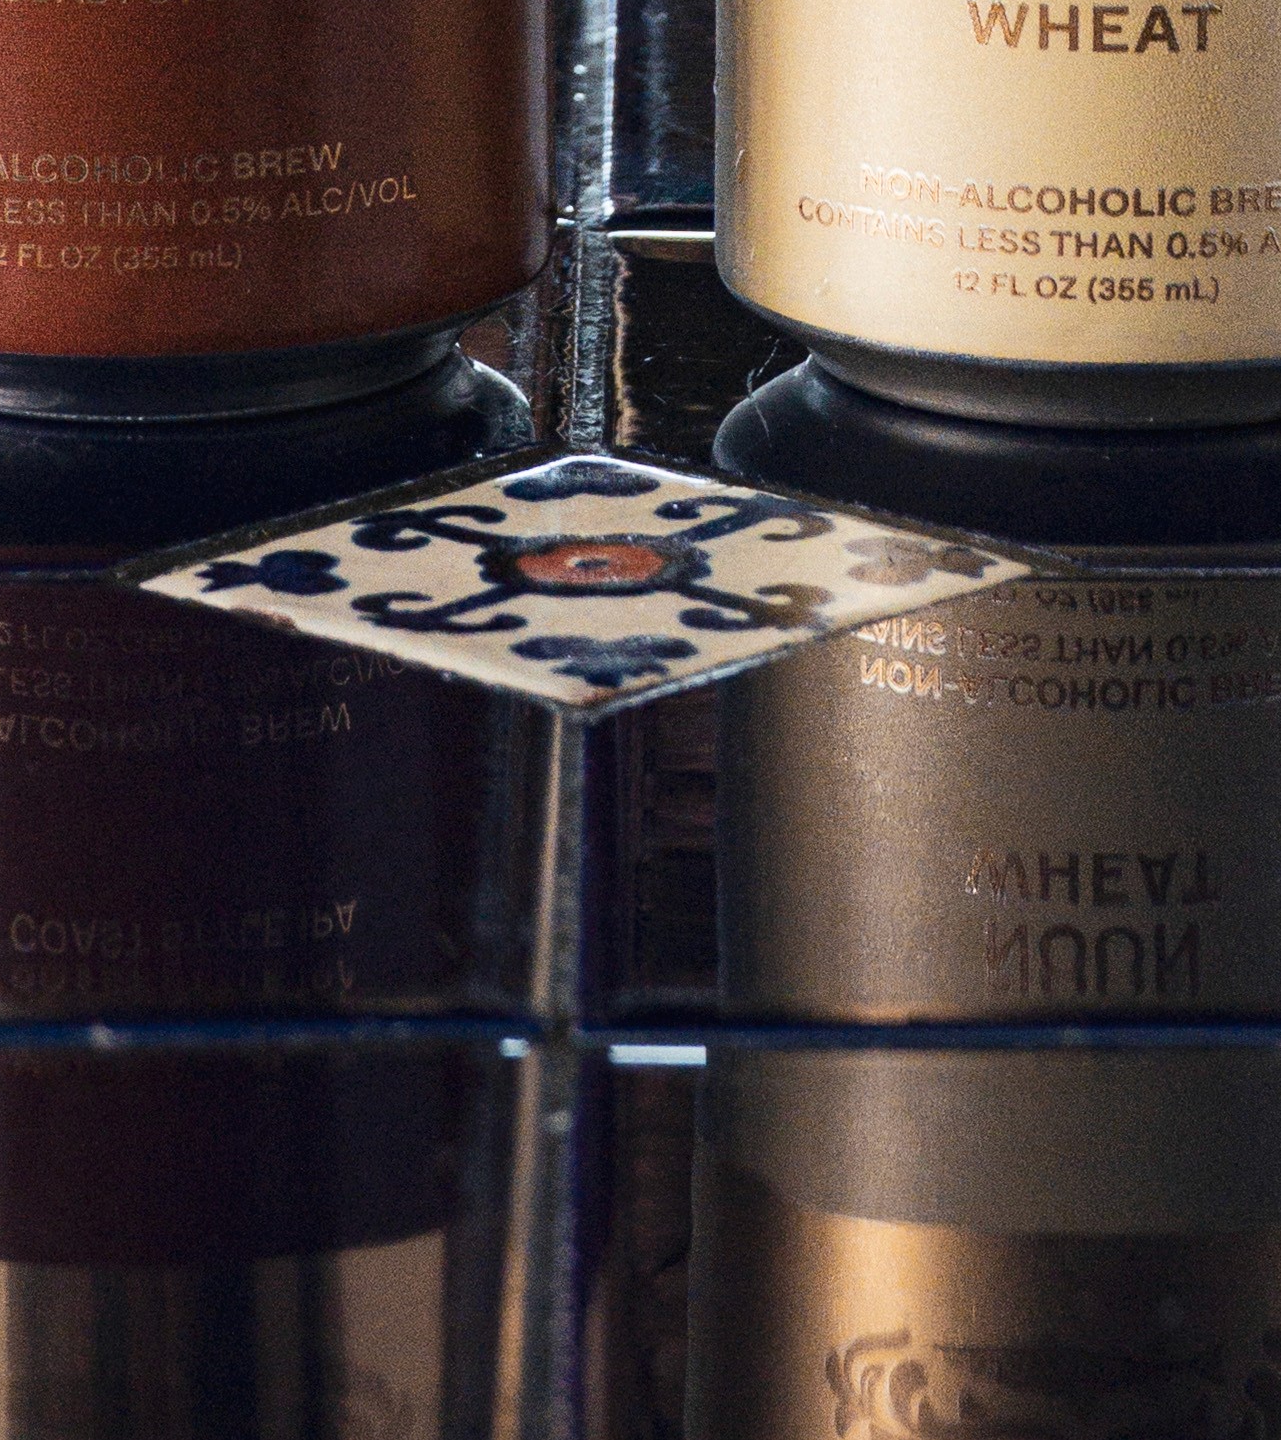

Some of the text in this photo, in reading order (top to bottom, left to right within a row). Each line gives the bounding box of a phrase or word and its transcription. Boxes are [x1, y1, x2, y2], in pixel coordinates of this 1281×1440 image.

[232, 140, 344, 179] BREW
[76, 195, 177, 228] THAN
[190, 191, 272, 226] 0.5%
[281, 174, 418, 219] ALC/VOL
[859, 163, 1196, 217] NON-ALCOHOLIC
[798, 194, 946, 251] CONTAINS
[957, 225, 1042, 256] LESS
[1050, 230, 1153, 260] THAN
[1166, 227, 1249, 260] 0.5%
[17, 242, 53, 270] FL
[59, 243, 104, 271] OZ
[112, 241, 180, 274] (355
[187, 239, 244, 271] mL)
[952, 268, 1221, 306] 12 FL OZ (355 mL)
